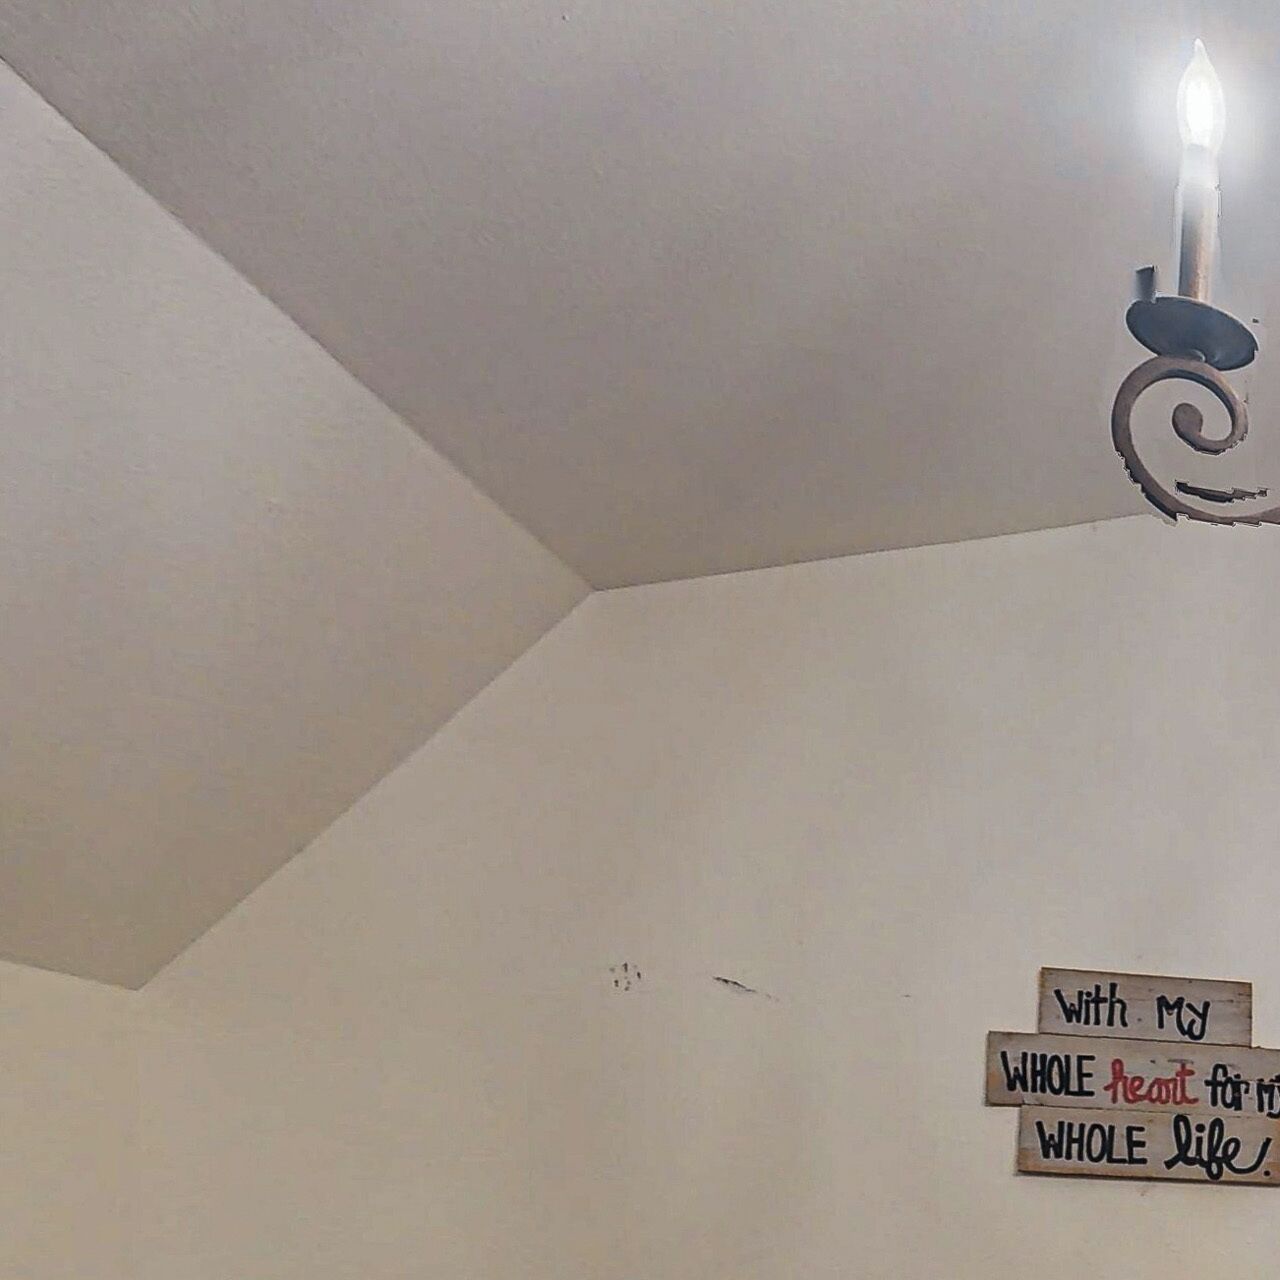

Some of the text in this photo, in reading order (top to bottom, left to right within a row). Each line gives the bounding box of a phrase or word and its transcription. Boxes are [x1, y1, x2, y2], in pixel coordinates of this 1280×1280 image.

[1001, 1050, 1096, 1097] WHOLE
[1103, 1057, 1200, 1105] heart
[1204, 1062, 1250, 1112] for
[1036, 1120, 1148, 1165] WHOLE
